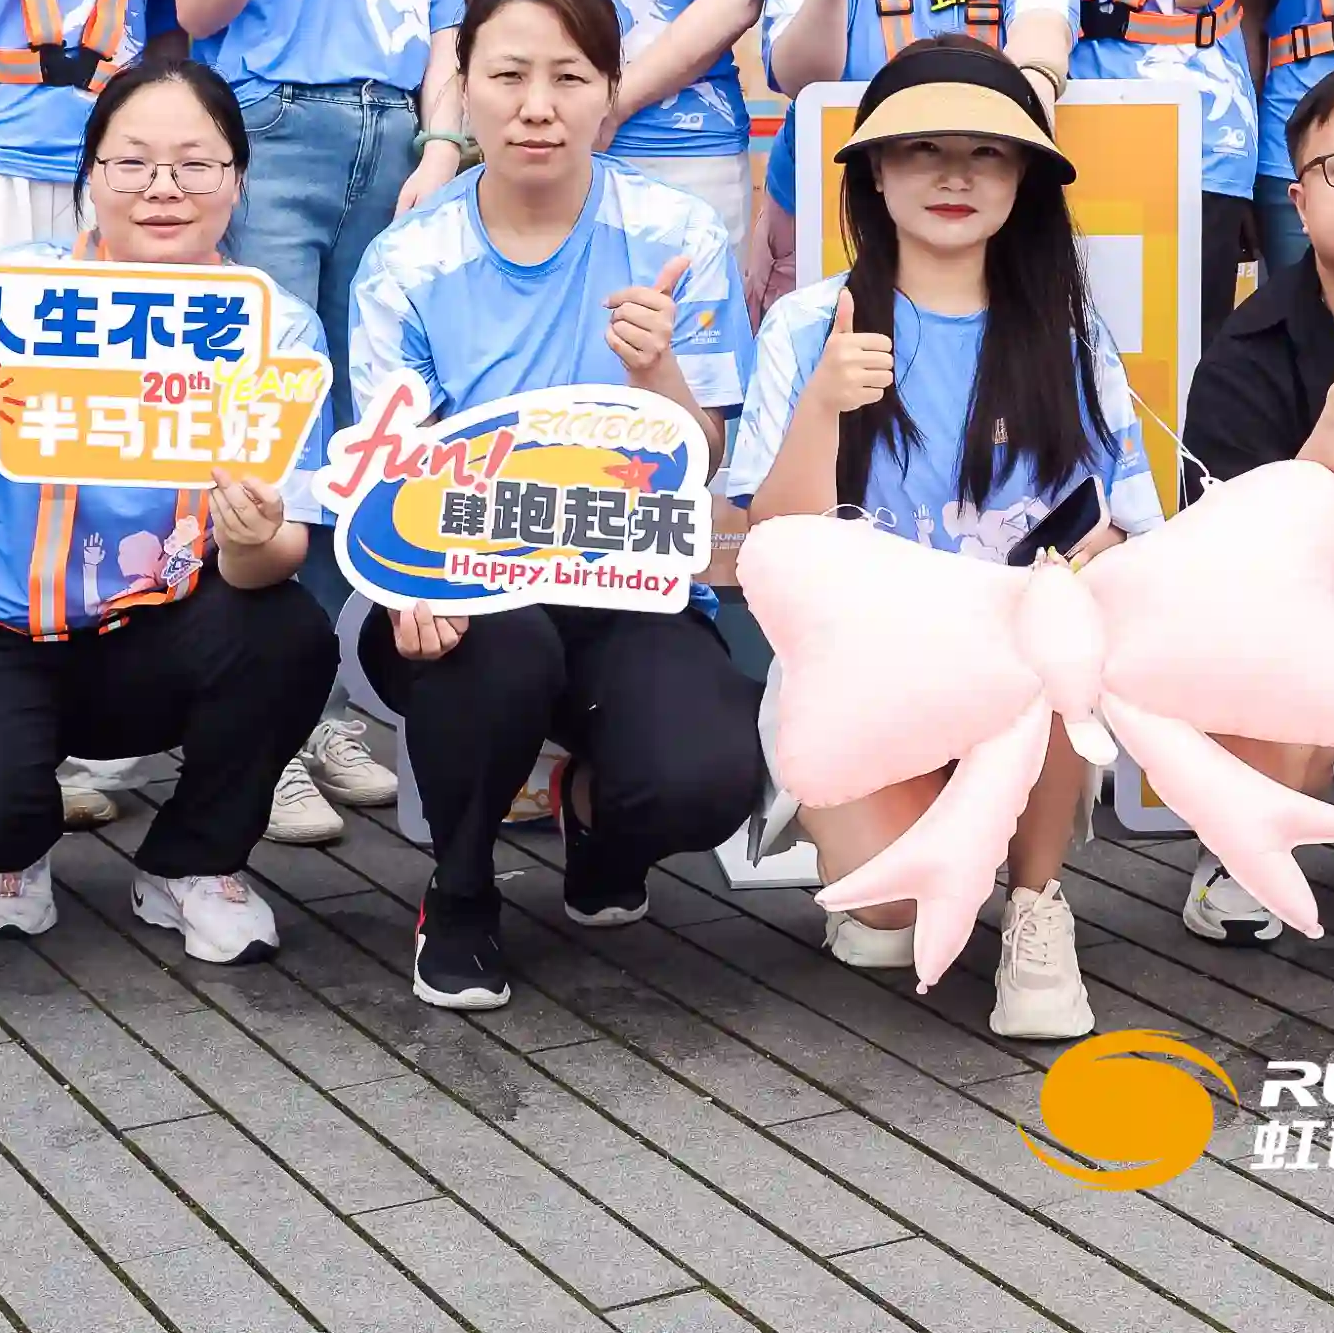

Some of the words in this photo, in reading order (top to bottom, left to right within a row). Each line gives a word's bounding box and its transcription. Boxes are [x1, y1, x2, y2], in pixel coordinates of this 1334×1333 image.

[143, 371, 211, 404] 20th
[20, 393, 283, 463] 半马正好
[328, 384, 515, 494] fun!
[441, 481, 696, 557] 肆跑起来
[451, 553, 544, 585] Happy
[555, 561, 679, 596] birthday
